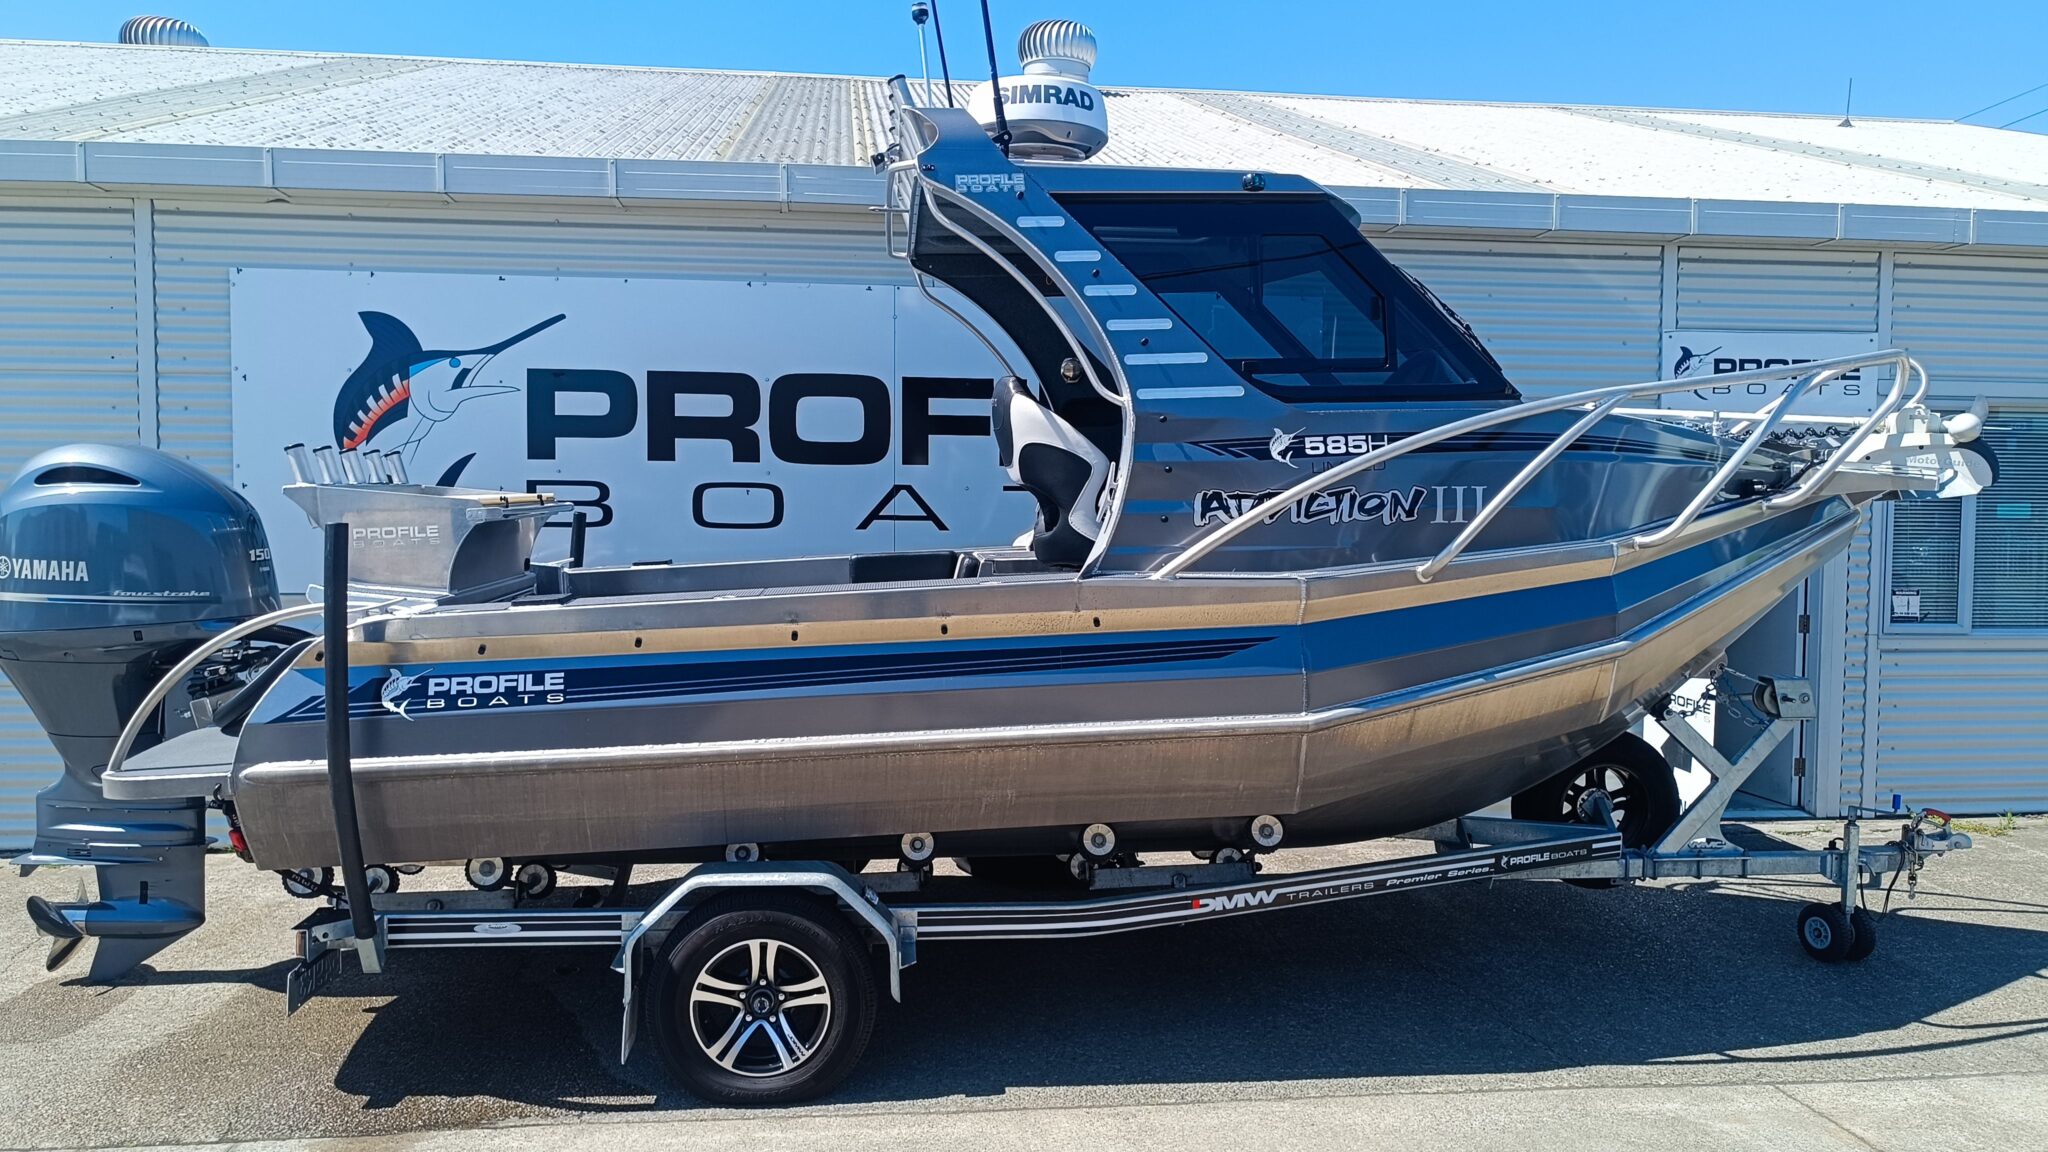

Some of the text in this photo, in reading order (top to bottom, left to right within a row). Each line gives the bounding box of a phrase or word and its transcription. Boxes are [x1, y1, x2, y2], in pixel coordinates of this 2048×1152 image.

[1000, 84, 1095, 112] SIMRAD
[955, 172, 1025, 186] PROFILE
[527, 368, 1050, 467] PROF
[1304, 434, 1388, 455] 585H
[352, 525, 439, 540] PROFILE
[353, 537, 440, 549] BOATS
[249, 547, 270, 561] 150
[11, 558, 89, 582] YAMAHA
[428, 672, 565, 696] PROFILE
[426, 693, 565, 709] BOATS
[1510, 848, 1588, 867] PROFILE BOATS
[1192, 866, 1488, 912] DMW TRAILERS Premier Series
